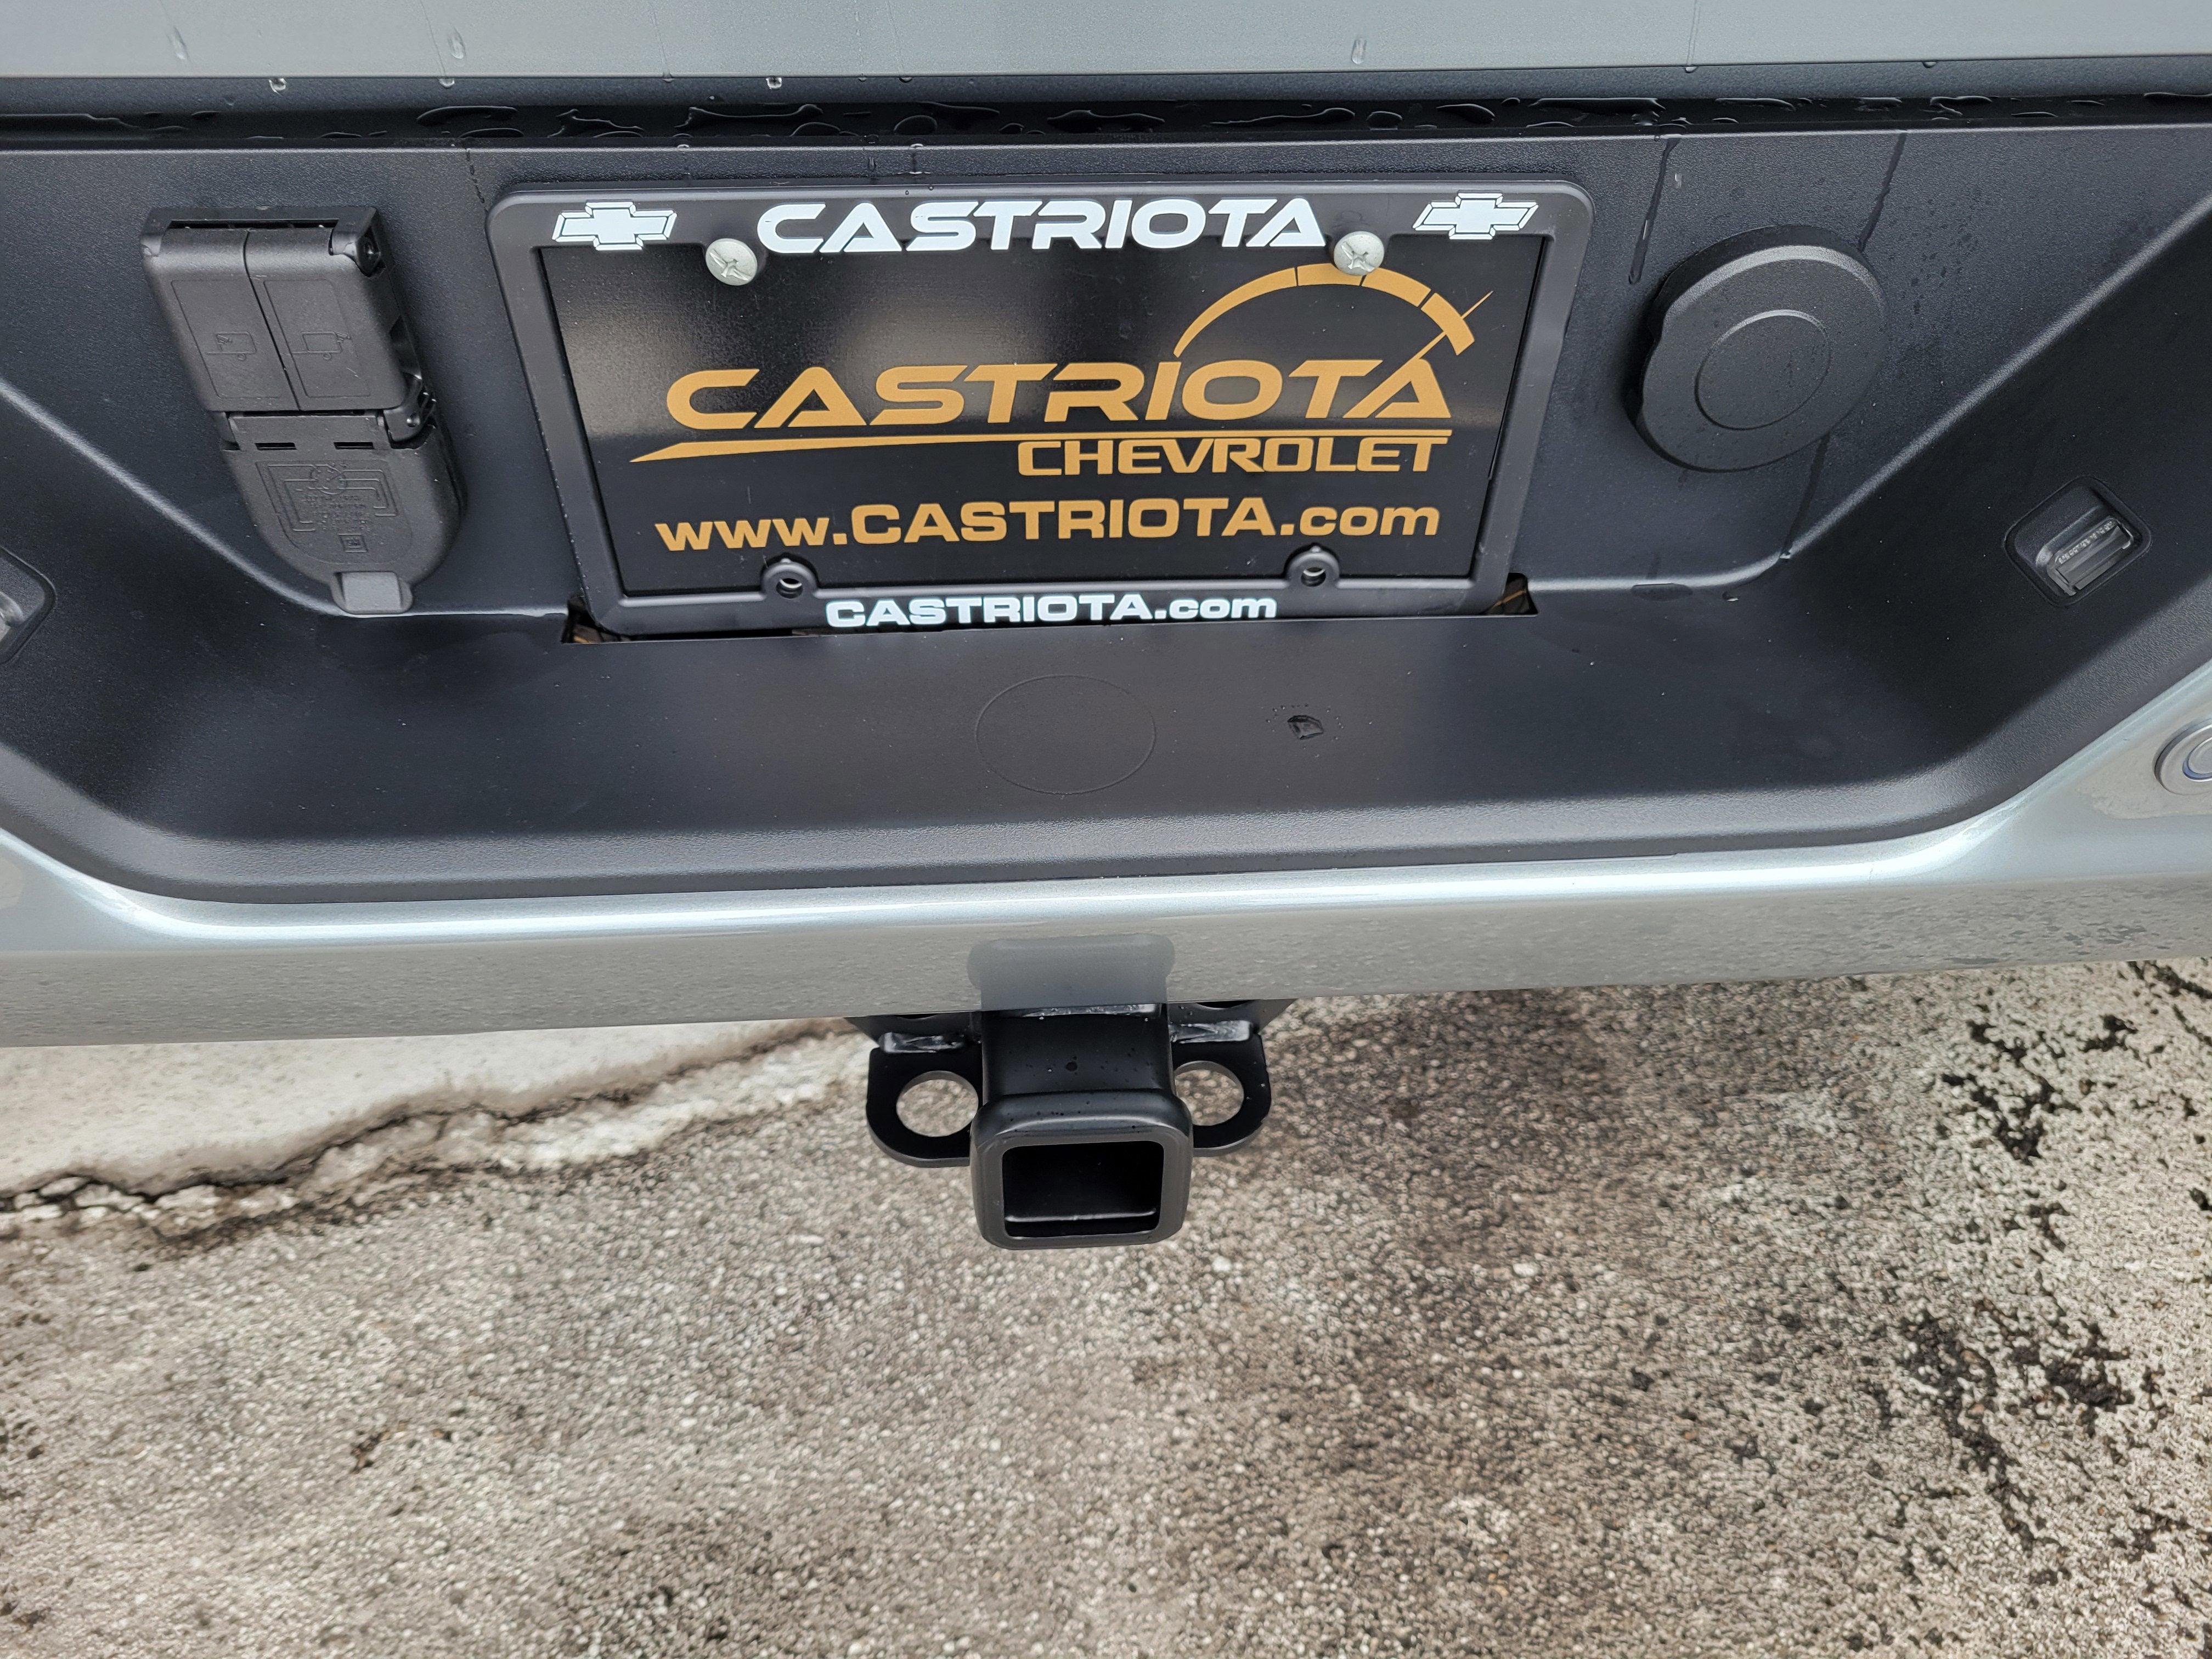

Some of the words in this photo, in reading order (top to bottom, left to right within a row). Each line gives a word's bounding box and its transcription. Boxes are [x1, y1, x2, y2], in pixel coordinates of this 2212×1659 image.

[757, 198, 1325, 253] CASTRIOTA
[667, 359, 1450, 430] CASTRIOTA
[1018, 437, 1447, 476] CHEVROLET
[656, 498, 1438, 550] www.CASTRIOTA.com
[826, 594, 1277, 627] CASTRIOTA.com
